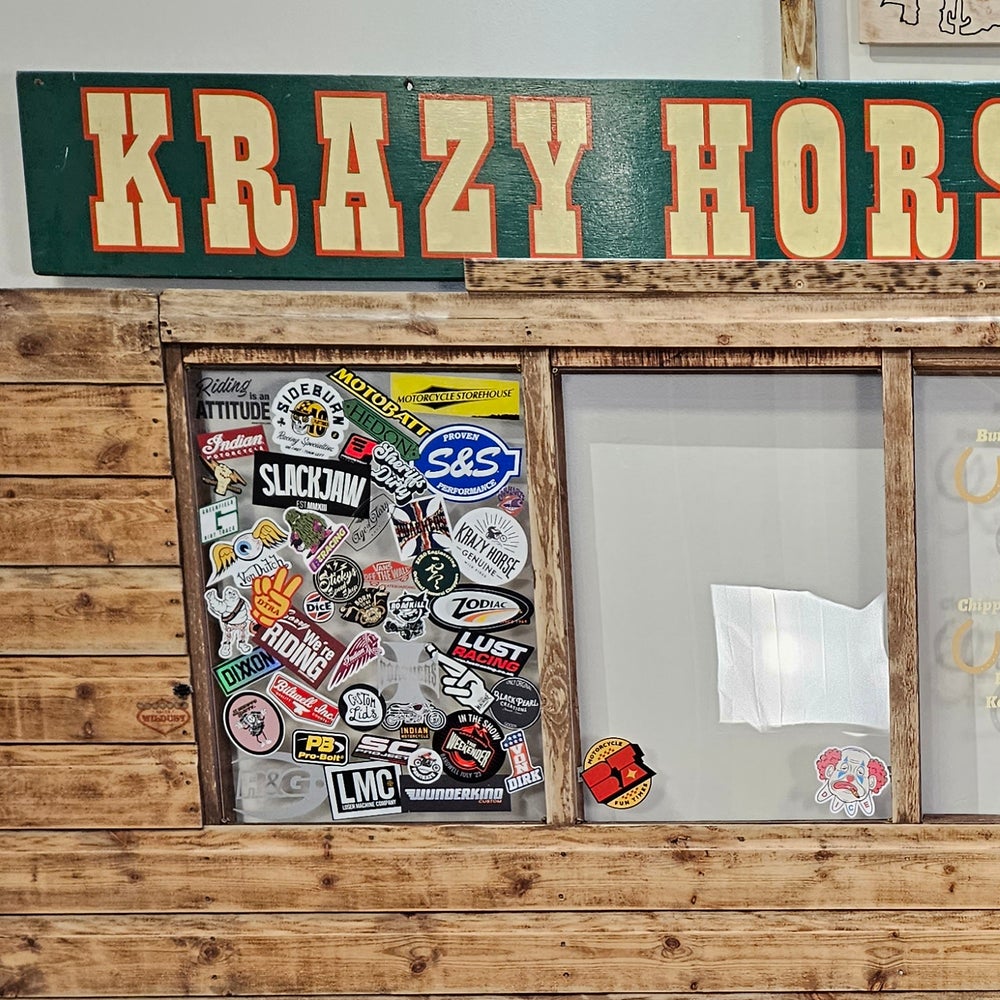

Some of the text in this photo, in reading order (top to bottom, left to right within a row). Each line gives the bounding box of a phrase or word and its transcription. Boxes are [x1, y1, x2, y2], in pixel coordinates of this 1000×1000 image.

[81, 87, 592, 258] KRAZY
[196, 377, 252, 397] Riding
[397, 388, 512, 404] MOTORCYCLE STOREHOUSE
[196, 400, 270, 420] ATTITUDE
[277, 383, 344, 426] SIDEBURN
[335, 368, 431, 437] MOTOBATT
[349, 404, 411, 457] HEDON
[443, 432, 480, 442] PROVEN
[202, 434, 264, 455] Indian
[206, 446, 264, 460] MOTORCYCLE
[424, 446, 501, 479] S&S
[259, 463, 367, 508] SLACKJAW
[436, 479, 497, 496] PERFORMANCE
[454, 522, 490, 554] KRAZY
[486, 546, 520, 580] HORSE
[372, 562, 392, 572] VANS
[461, 549, 497, 577] GENUINE
[377, 571, 391, 581] THE
[257, 599, 280, 616] DTRA
[451, 597, 507, 620] ZODIAC
[261, 625, 328, 681] RIDING
[302, 630, 335, 661] We're
[458, 631, 528, 661] LUST
[222, 651, 276, 687] DIXXON
[452, 646, 520, 673] RACING
[273, 679, 318, 709] Biltwell
[347, 693, 377, 709] CUSTOM
[350, 705, 378, 722] Lids
[401, 727, 429, 735] INDIAN
[468, 714, 483, 725] THE
[482, 720, 501, 741] SHOW
[305, 735, 336, 752] PB
[355, 748, 410, 761] PROJECT
[357, 736, 418, 756] SC
[446, 731, 492, 768] WEEKENDER
[588, 740, 623, 765] MOTORCYCLE
[298, 751, 341, 761] Pro-Bolt
[336, 768, 395, 805] LMC
[506, 769, 543, 791] DIRK
[631, 783, 648, 802] TIMES
